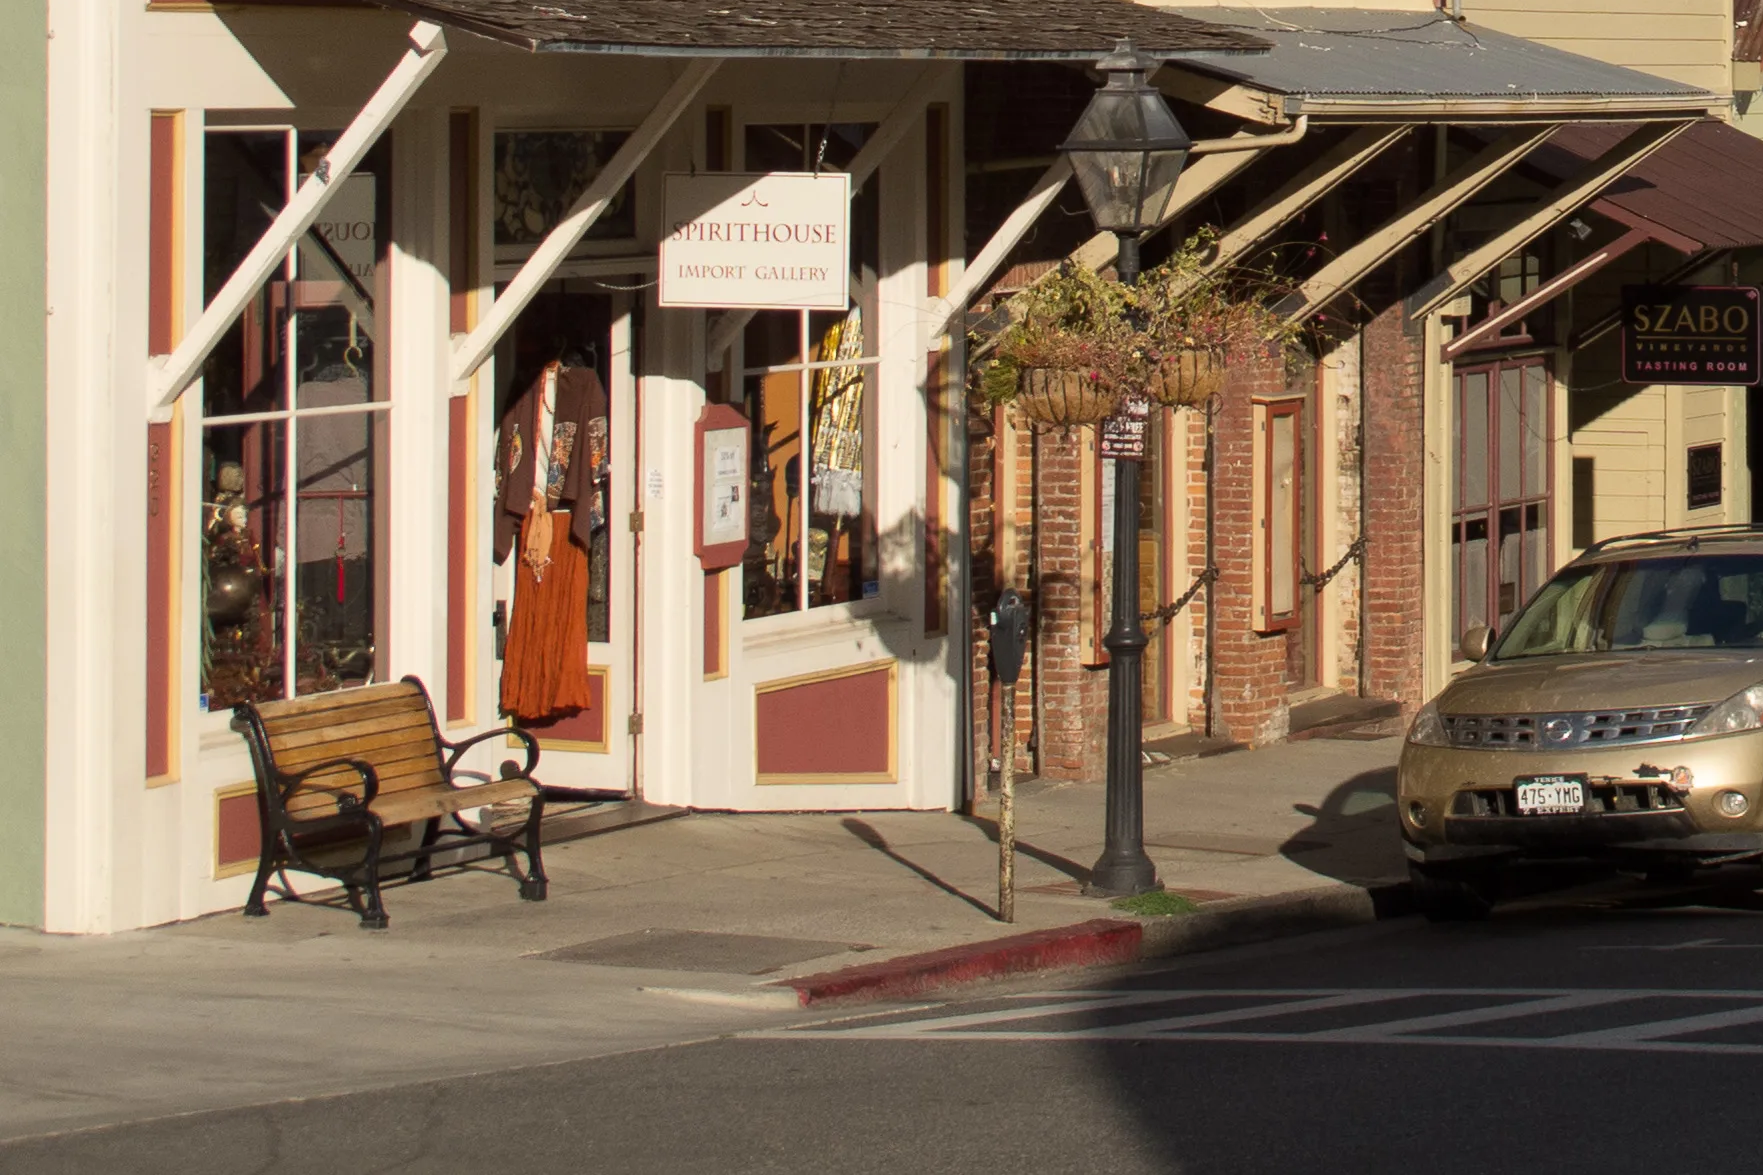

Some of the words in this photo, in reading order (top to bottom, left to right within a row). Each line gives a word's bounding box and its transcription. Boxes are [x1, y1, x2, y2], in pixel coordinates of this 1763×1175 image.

[672, 222, 837, 244] SPIRITHOUSE
[678, 264, 746, 280] IMPORT
[755, 265, 829, 282] GALLERY
[1633, 304, 1749, 333] SZABO
[1636, 343, 1747, 353] VINEYARDS
[1636, 361, 1698, 372] TASTING
[1706, 362, 1748, 372] ROOM
